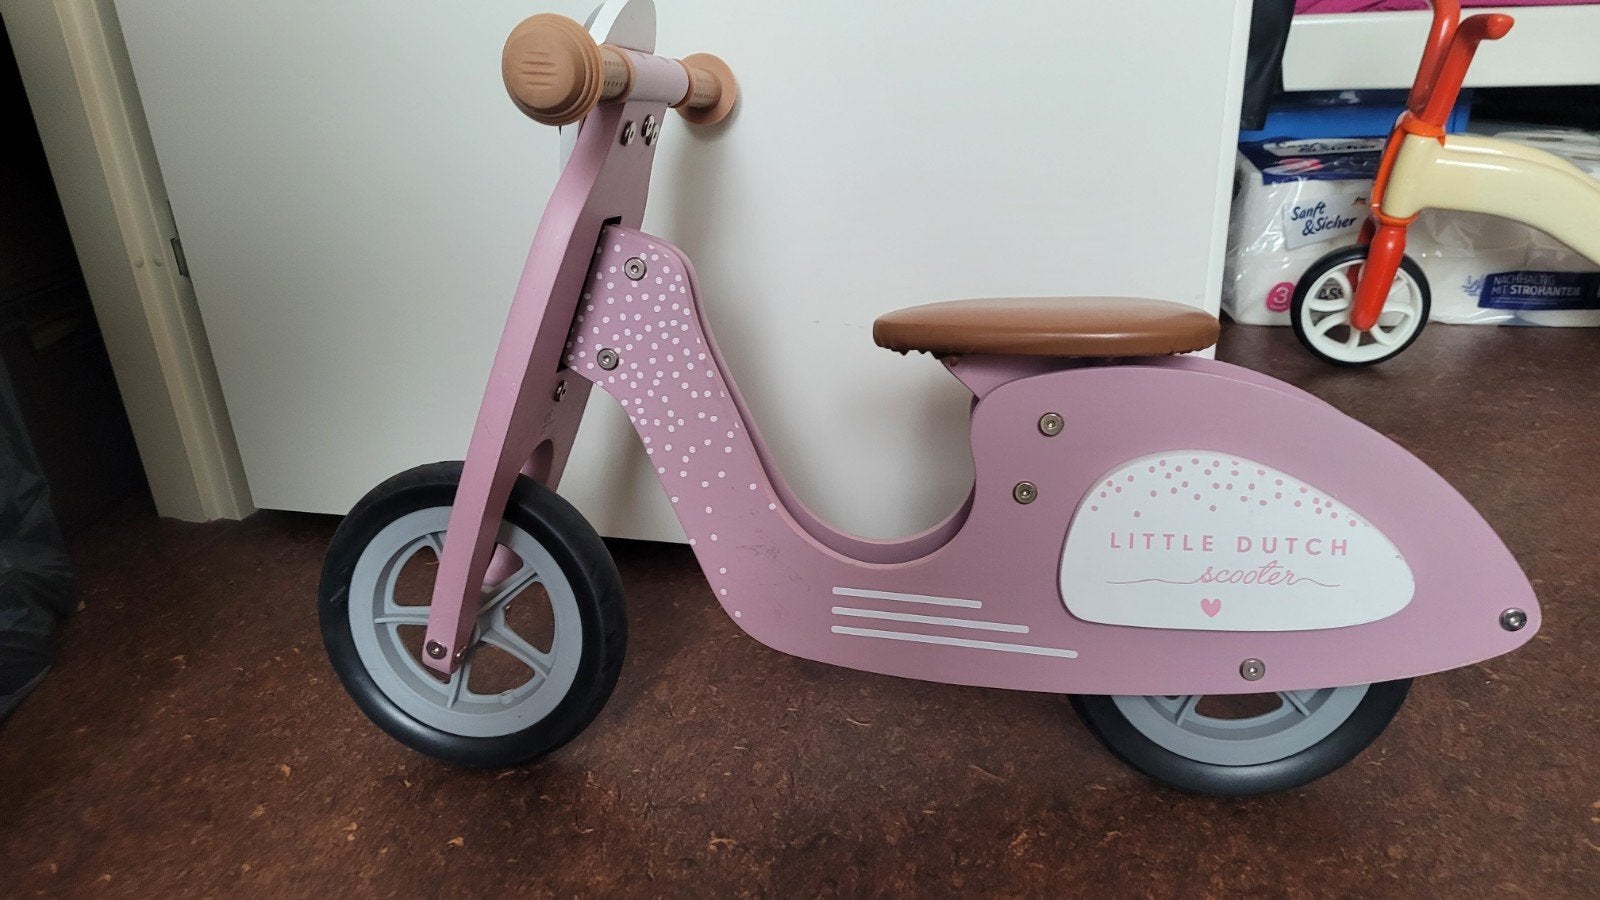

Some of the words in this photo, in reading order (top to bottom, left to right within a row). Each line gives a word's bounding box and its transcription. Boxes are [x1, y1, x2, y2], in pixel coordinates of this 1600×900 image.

[1291, 201, 1327, 221] Sanft
[1273, 286, 1290, 304] 3
[1491, 285, 1507, 295] MIT
[1510, 284, 1582, 297] STROHANTEIL
[1110, 532, 1214, 552] LITTLE
[1236, 535, 1348, 556] DUTCH
[1199, 559, 1297, 586] scooter
